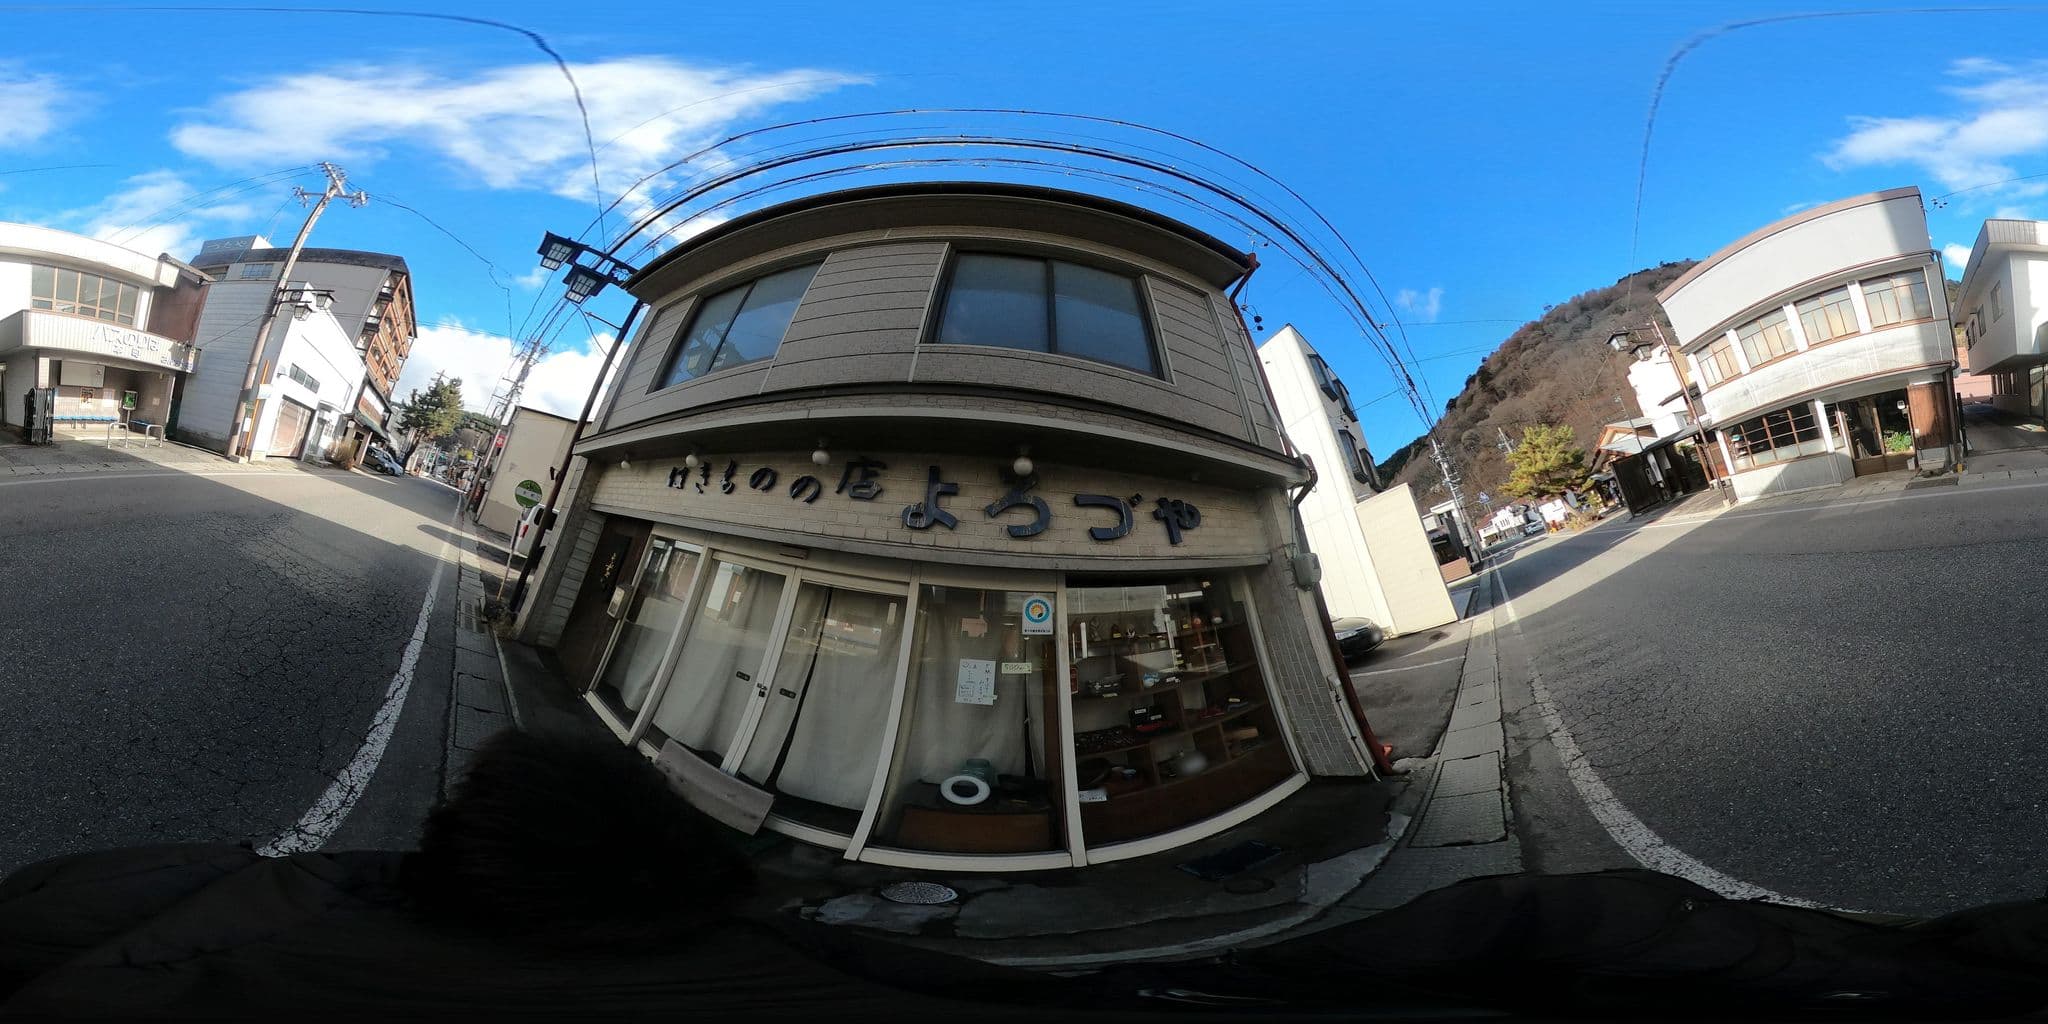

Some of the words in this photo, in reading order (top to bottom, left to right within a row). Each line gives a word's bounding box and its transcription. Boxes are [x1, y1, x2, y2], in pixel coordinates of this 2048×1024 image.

[667, 456, 887, 503] はきものの店
[902, 465, 1201, 546] よろづや
